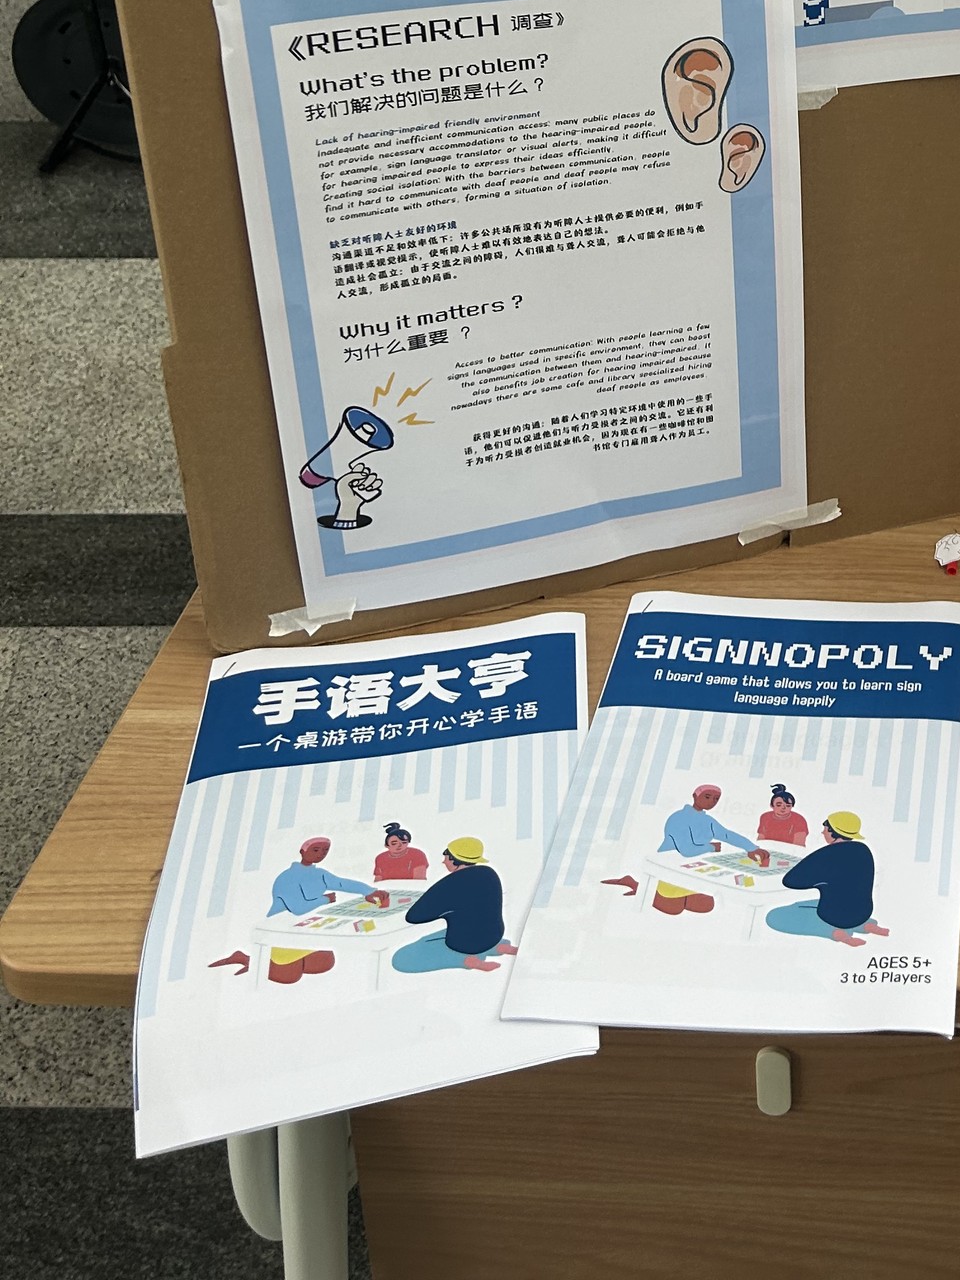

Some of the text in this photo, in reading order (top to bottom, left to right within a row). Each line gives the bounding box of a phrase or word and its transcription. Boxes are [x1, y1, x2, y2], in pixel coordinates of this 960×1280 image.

[299, 53, 549, 97] What's the problem?
[315, 110, 541, 146] Lack of hearing-impaired friendly environment
[329, 220, 457, 249] 缺乏对听障人士友好的环境
[339, 321, 390, 340] Why
[396, 314, 412, 330] it
[417, 300, 505, 326] matters
[634, 634, 953, 671] SIGNNOPOLY
[252, 650, 531, 726] 手语大亨
[653, 668, 922, 693] A board game that allows you to learn sign
[733, 691, 836, 708] language happily
[238, 701, 539, 752] 一个桌游带你开心学手语
[840, 971, 932, 985] 3 to 5 Players
[866, 956, 932, 969] AGES 5+
